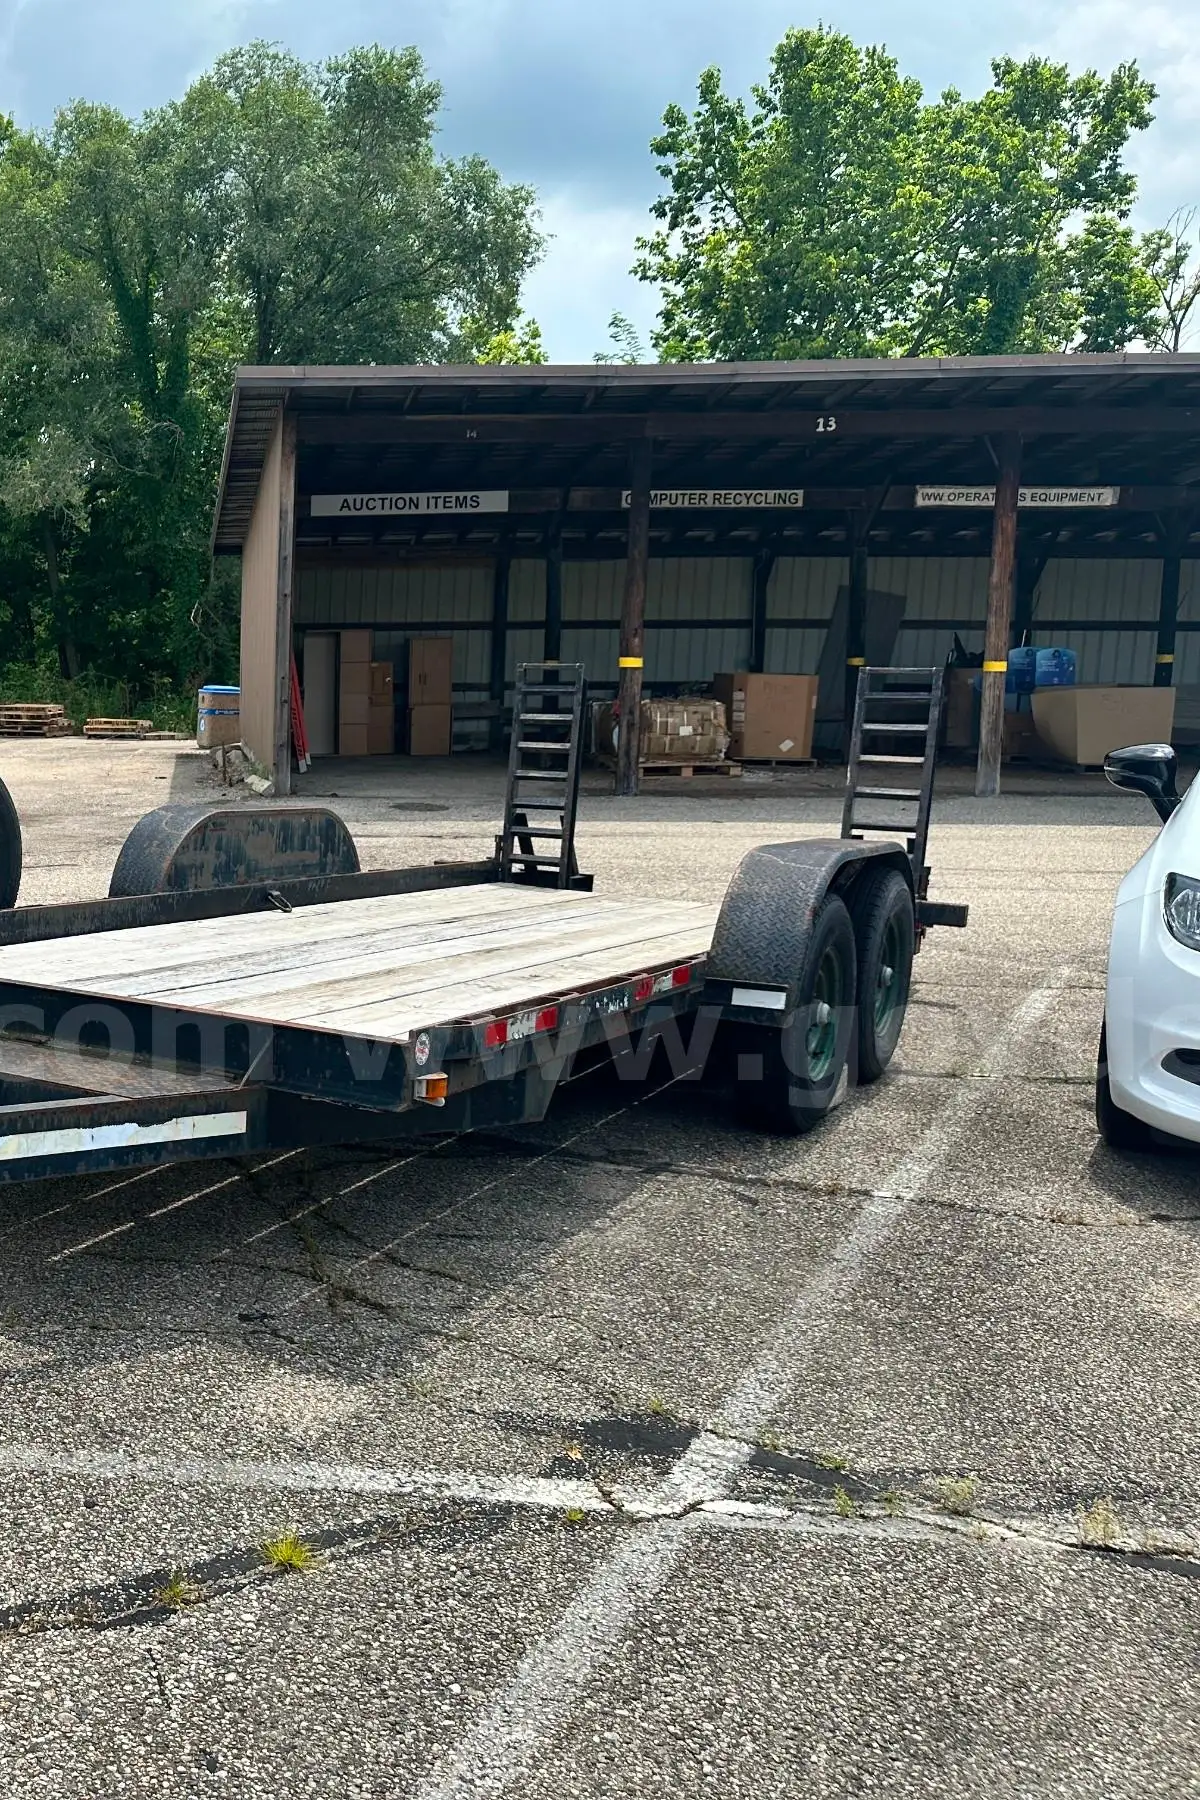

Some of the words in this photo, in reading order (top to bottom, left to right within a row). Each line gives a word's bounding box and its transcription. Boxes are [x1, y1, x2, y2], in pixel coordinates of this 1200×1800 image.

[815, 417, 837, 432] 13
[339, 496, 420, 512] AUCTION
[426, 494, 481, 510] ITEMS
[625, 492, 708, 506] CMPUTER
[713, 491, 799, 506] RECYCLING
[921, 492, 945, 502] WW
[947, 492, 1026, 502] OPERATS
[1031, 492, 1104, 502] EQUIPMENT
